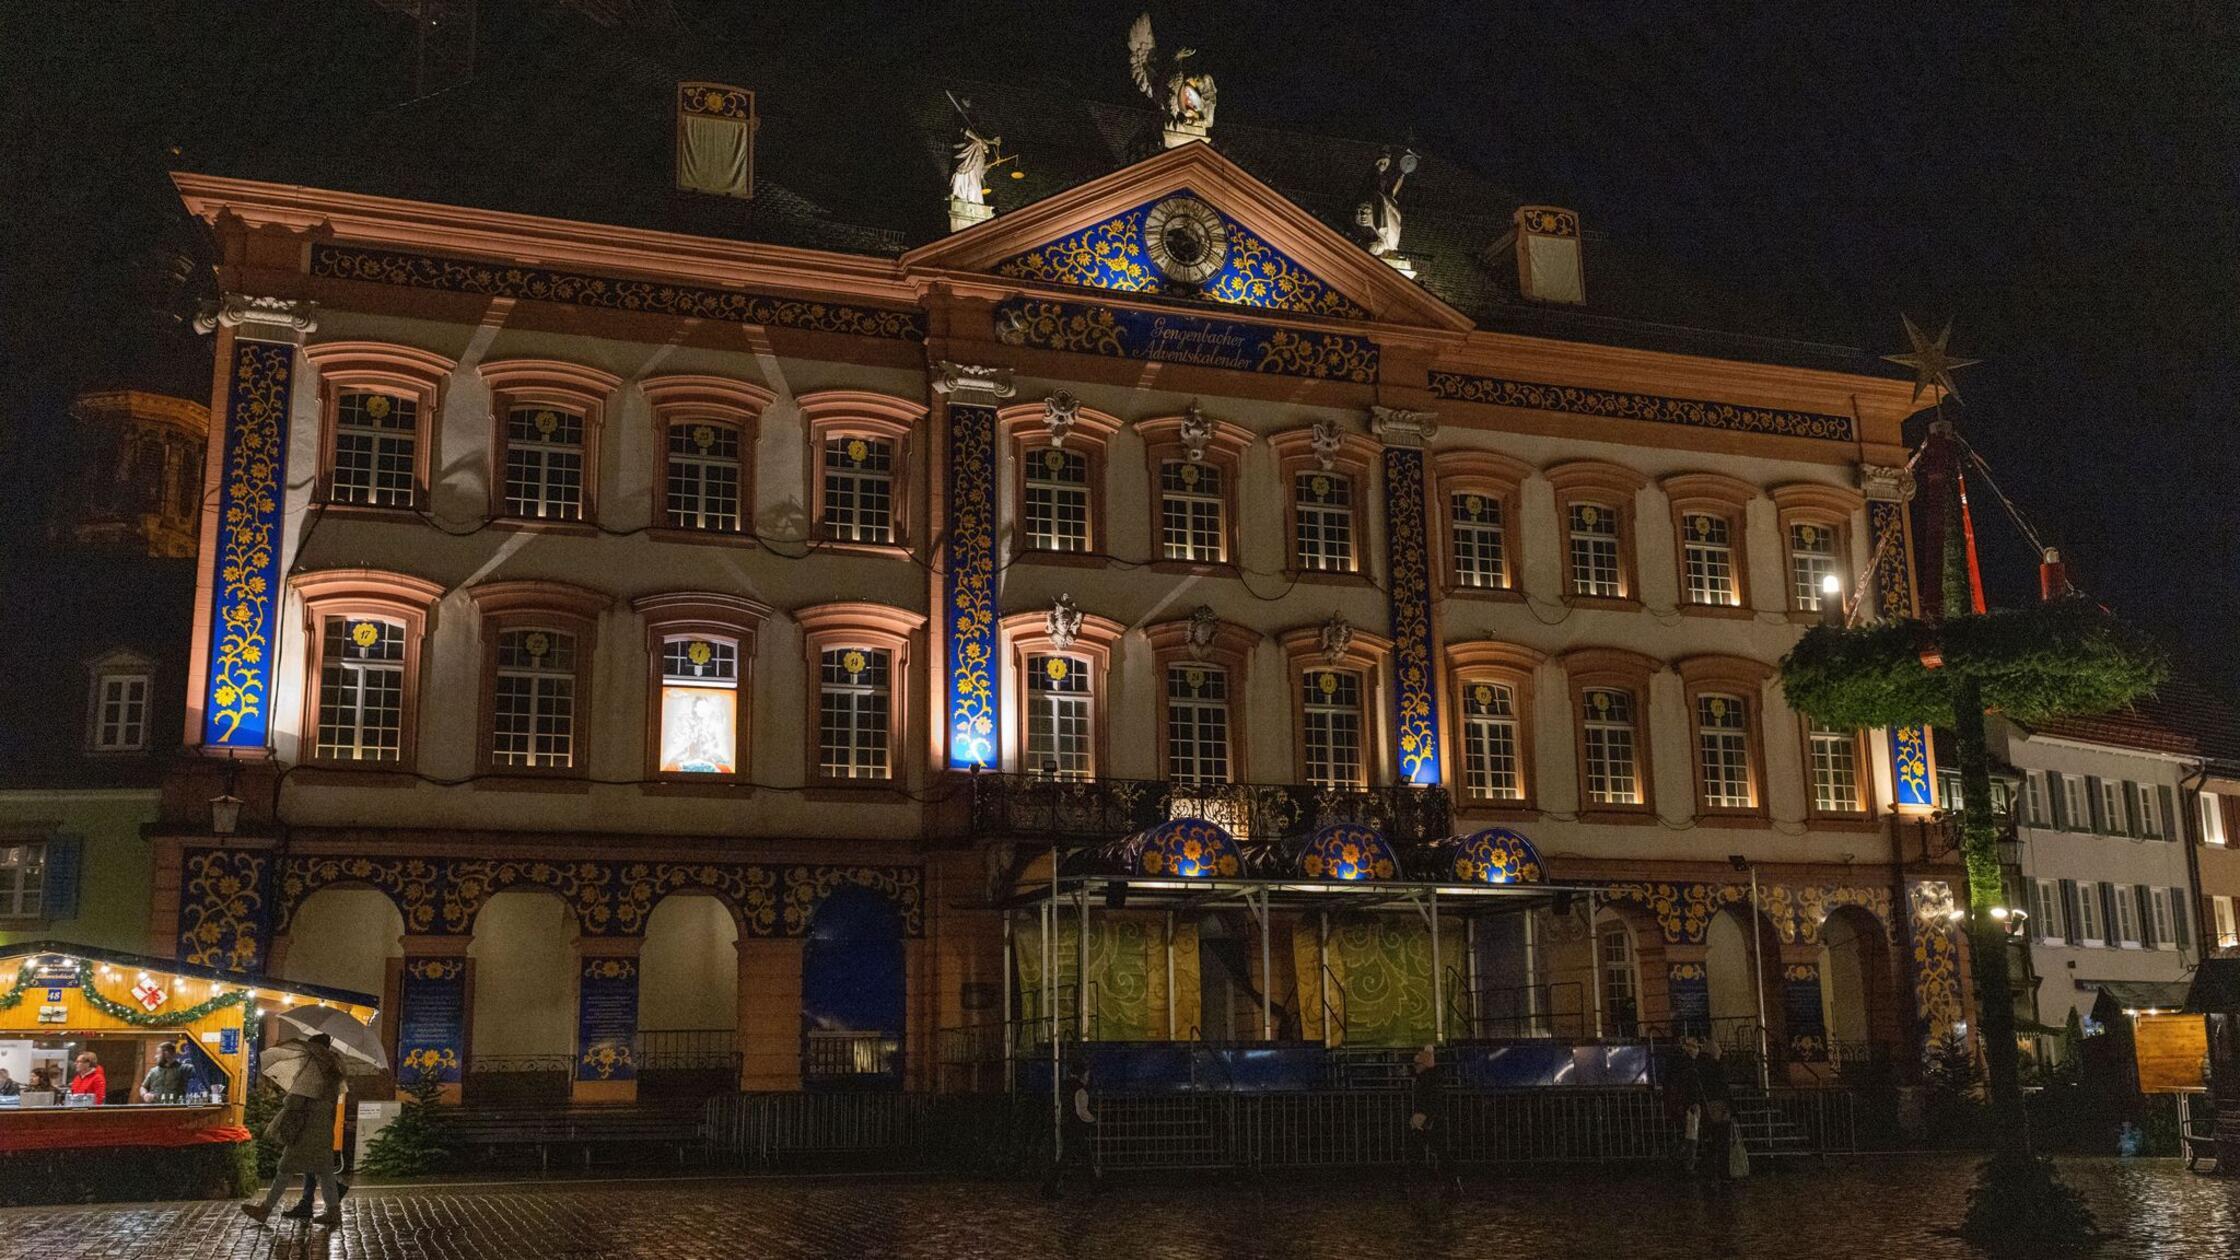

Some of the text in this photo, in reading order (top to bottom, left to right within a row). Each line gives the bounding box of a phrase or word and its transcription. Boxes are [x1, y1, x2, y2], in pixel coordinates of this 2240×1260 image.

[1151, 317, 1247, 350] Gengenbacher
[1132, 340, 1252, 369] Adventskalender
[360, 629, 371, 640] 17
